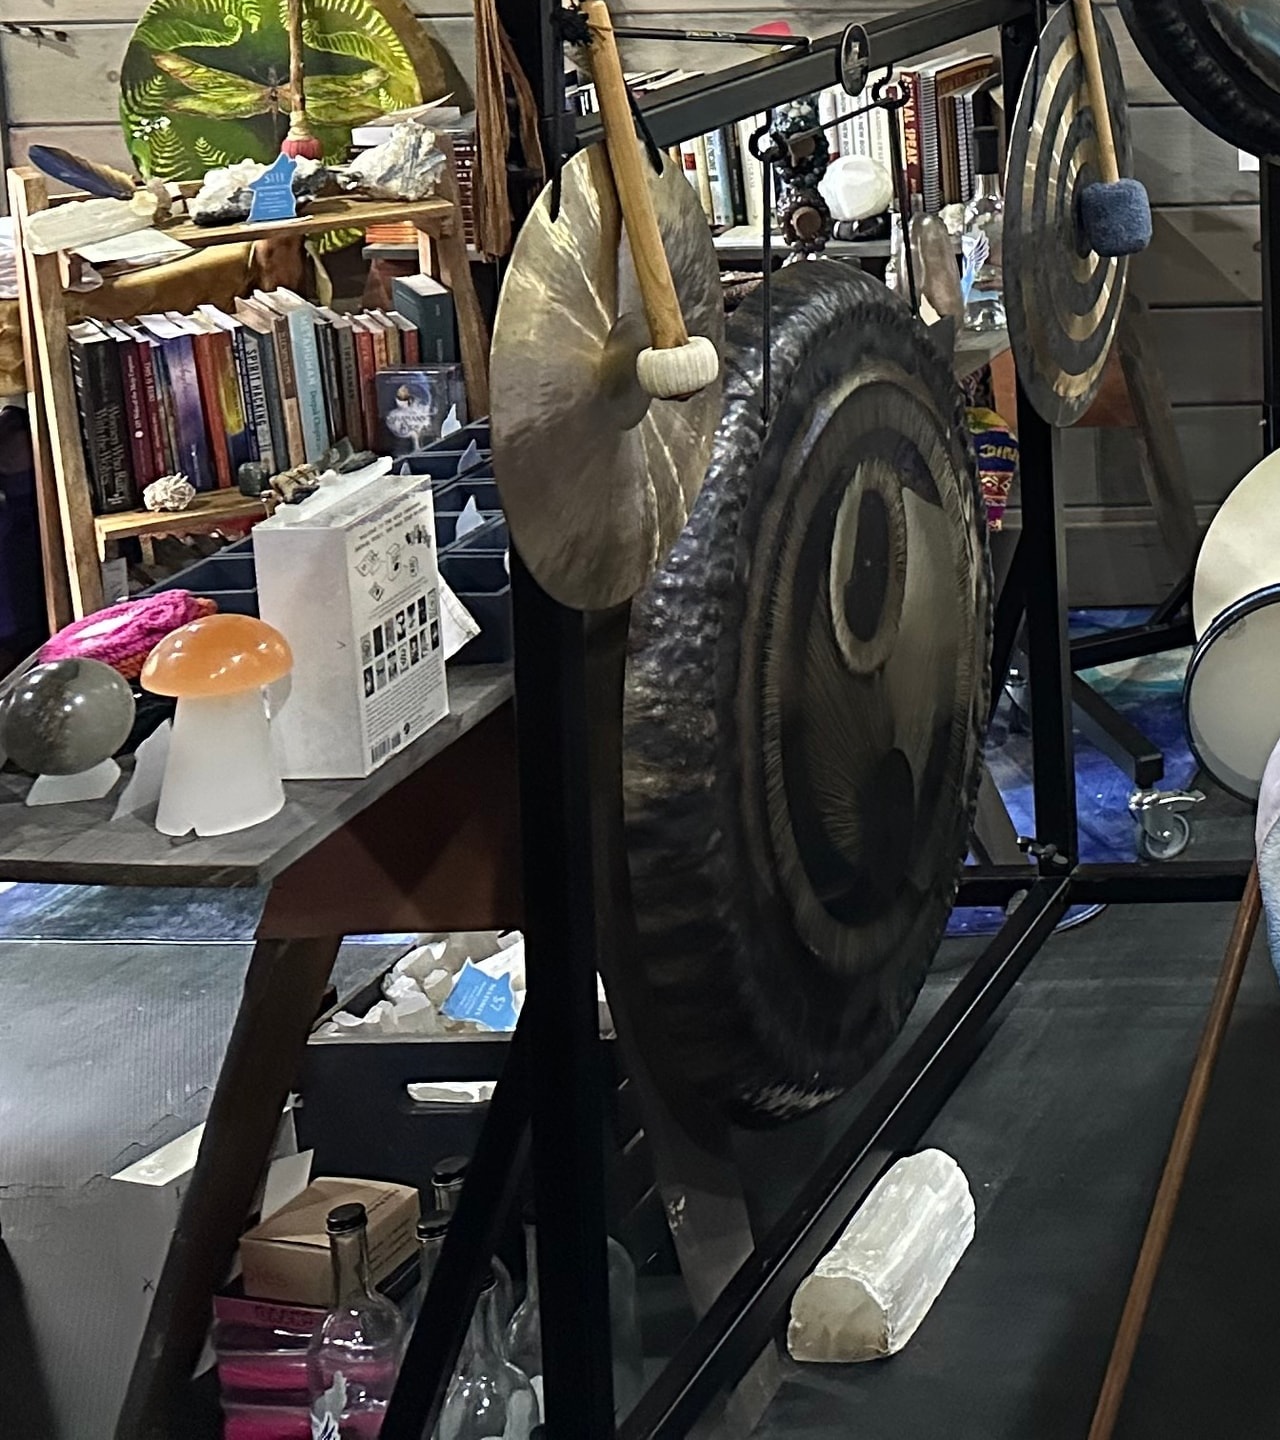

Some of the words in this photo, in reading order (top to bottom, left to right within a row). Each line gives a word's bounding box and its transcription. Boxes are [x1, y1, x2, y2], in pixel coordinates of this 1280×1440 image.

[905, 128, 918, 165] SPEAK
[245, 349, 262, 382] SPIRIT
[298, 315, 318, 386] METAHUMAN
[251, 384, 268, 427] HACKING
